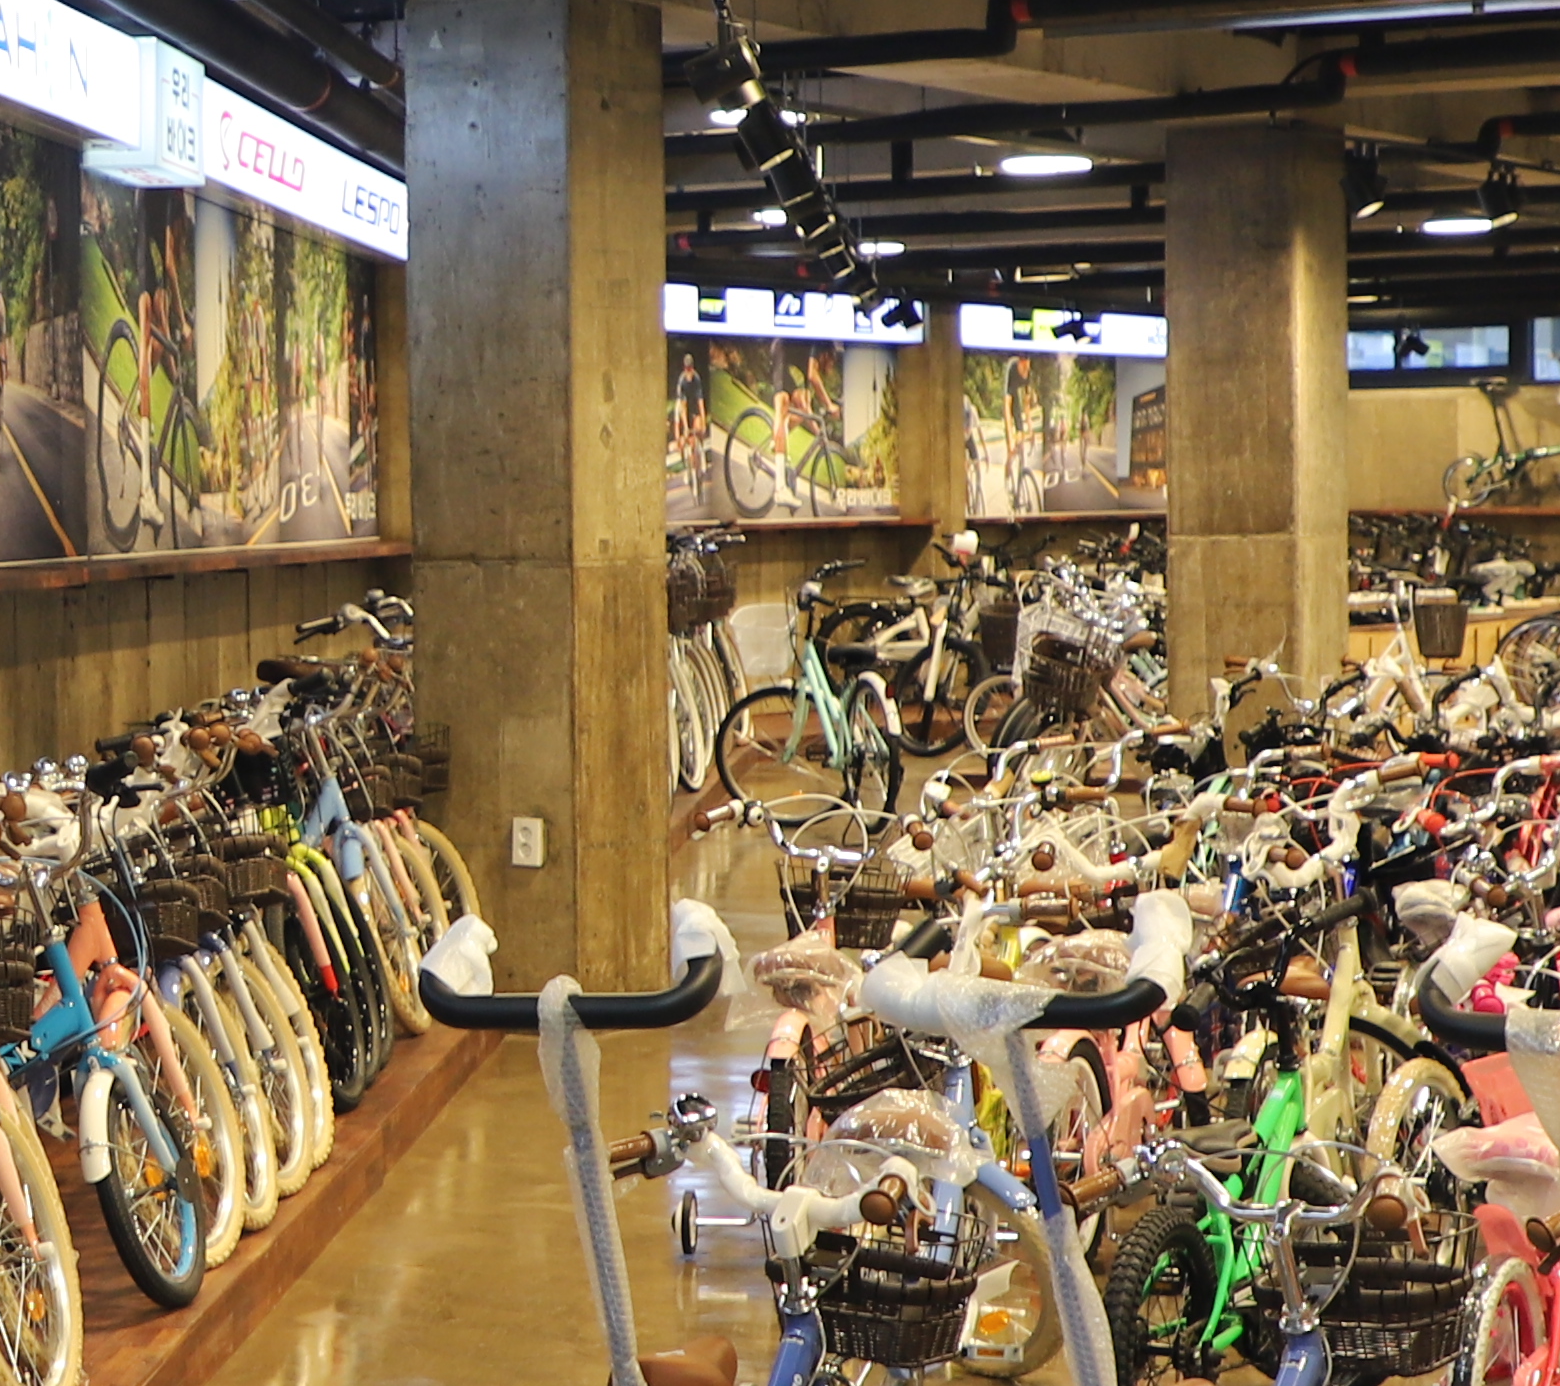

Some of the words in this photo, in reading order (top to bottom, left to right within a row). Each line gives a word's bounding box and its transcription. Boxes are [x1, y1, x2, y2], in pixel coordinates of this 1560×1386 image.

[172, 66, 190, 111] 우리
[166, 115, 196, 163] 바이크
[237, 131, 305, 192] CELLO
[342, 179, 401, 235] LESPO
